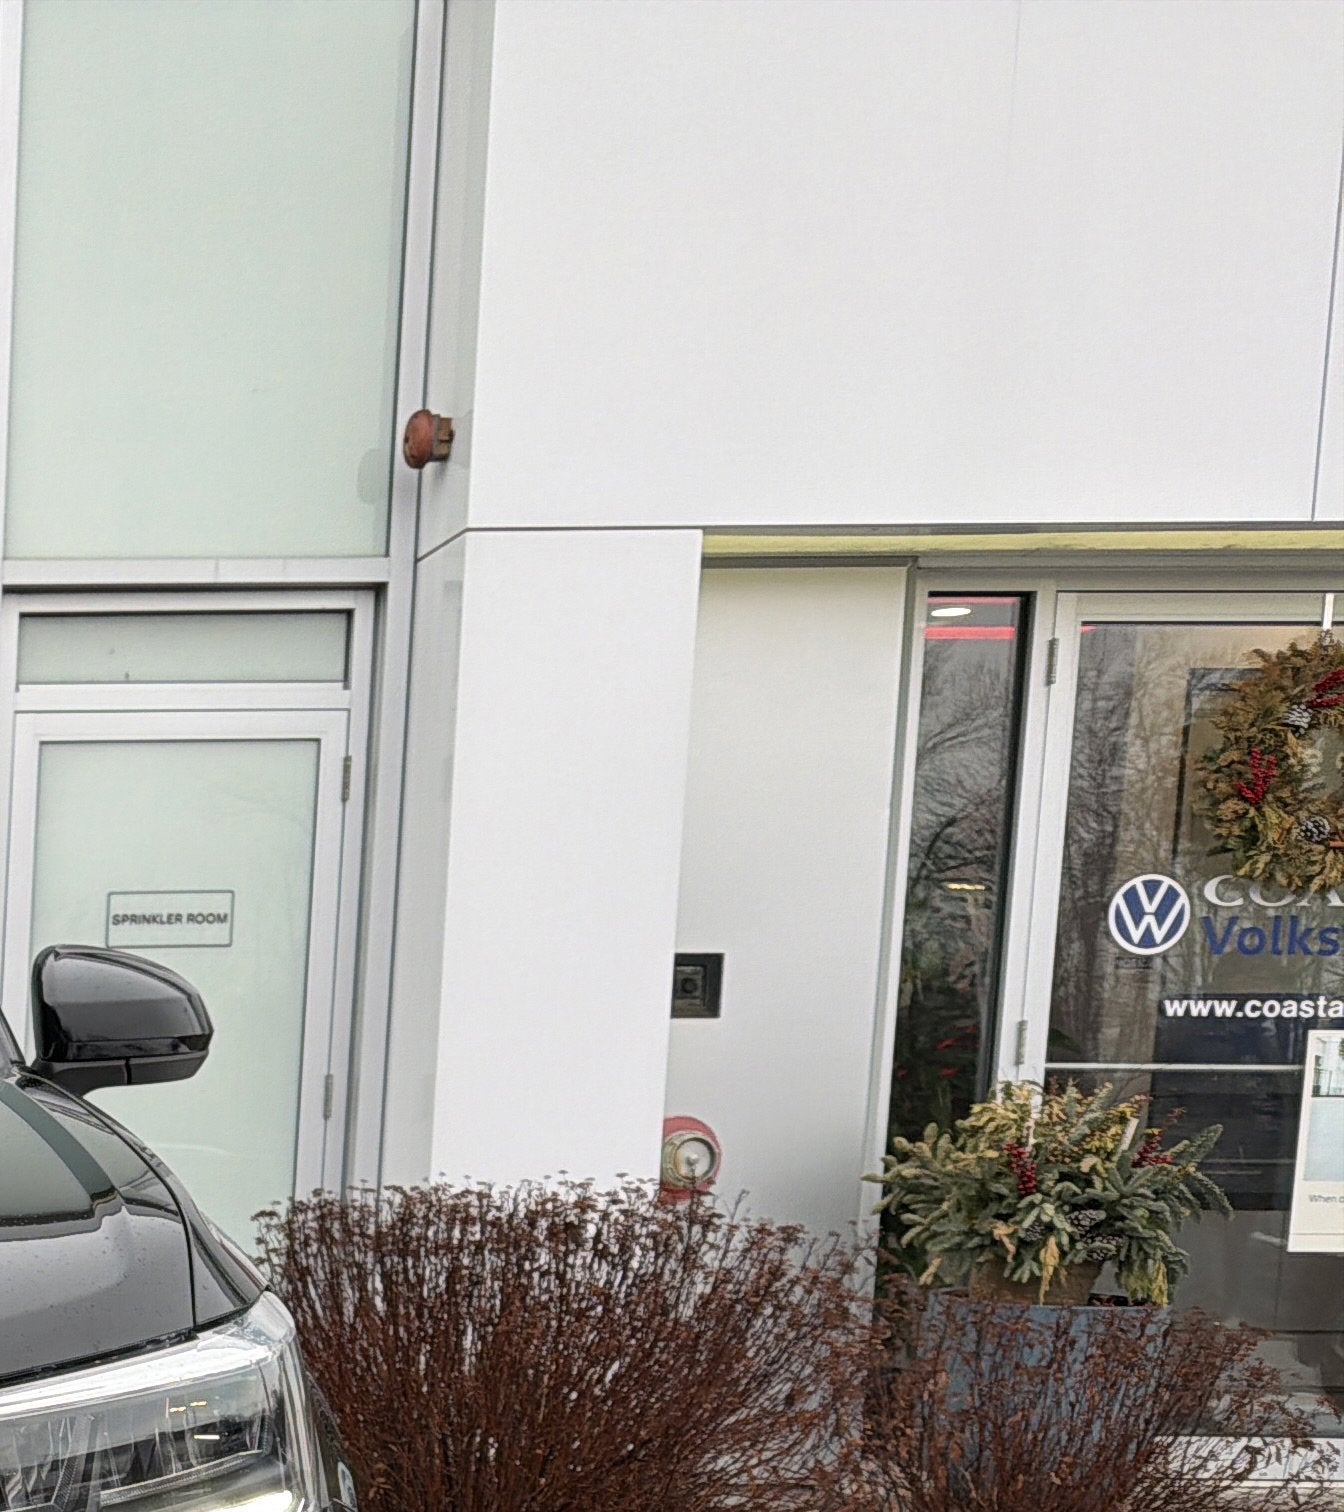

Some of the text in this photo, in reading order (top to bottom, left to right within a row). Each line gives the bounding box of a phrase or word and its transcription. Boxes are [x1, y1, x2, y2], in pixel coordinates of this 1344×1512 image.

[112, 912, 228, 925] SPRINKLER ROOM
[1201, 915, 1341, 956] Volks
